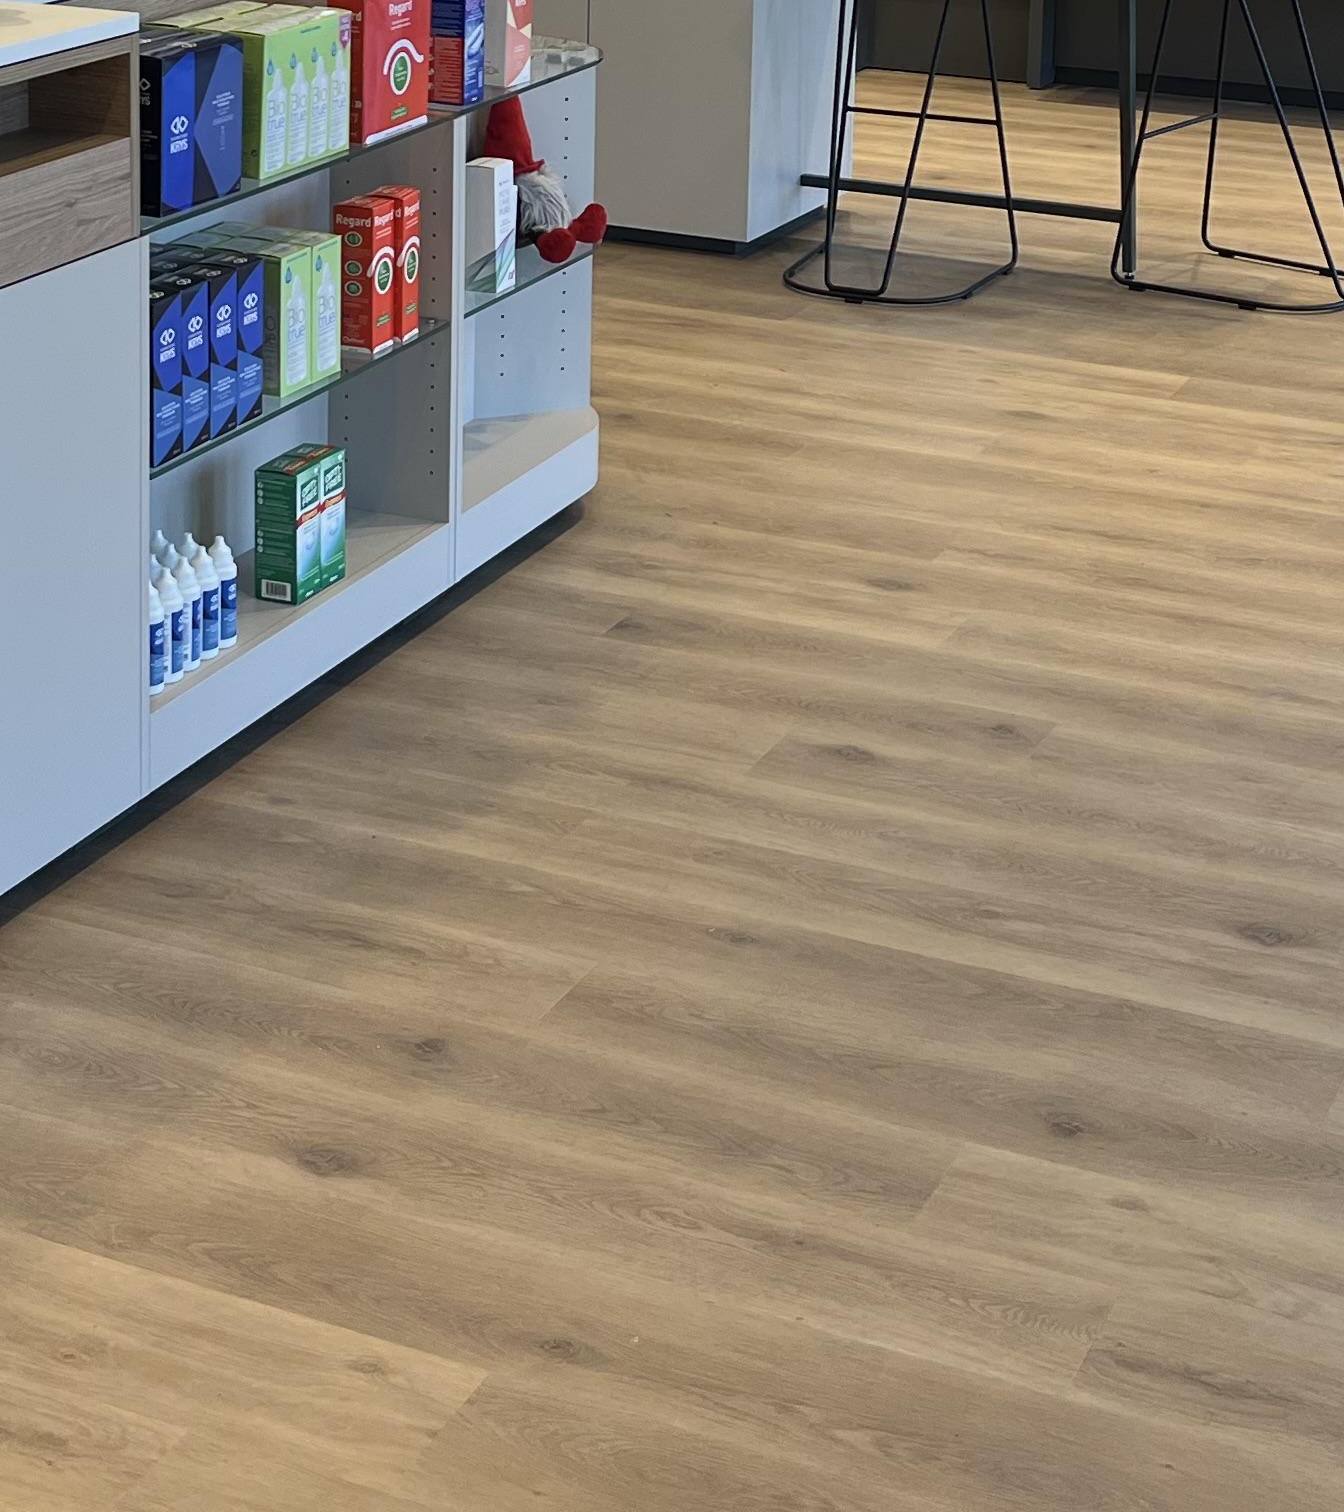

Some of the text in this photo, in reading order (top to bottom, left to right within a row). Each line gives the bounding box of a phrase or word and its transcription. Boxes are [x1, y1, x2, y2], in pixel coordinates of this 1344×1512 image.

[169, 138, 189, 155] KRYS
[336, 212, 372, 228] Regard
[374, 209, 394, 228] Regard
